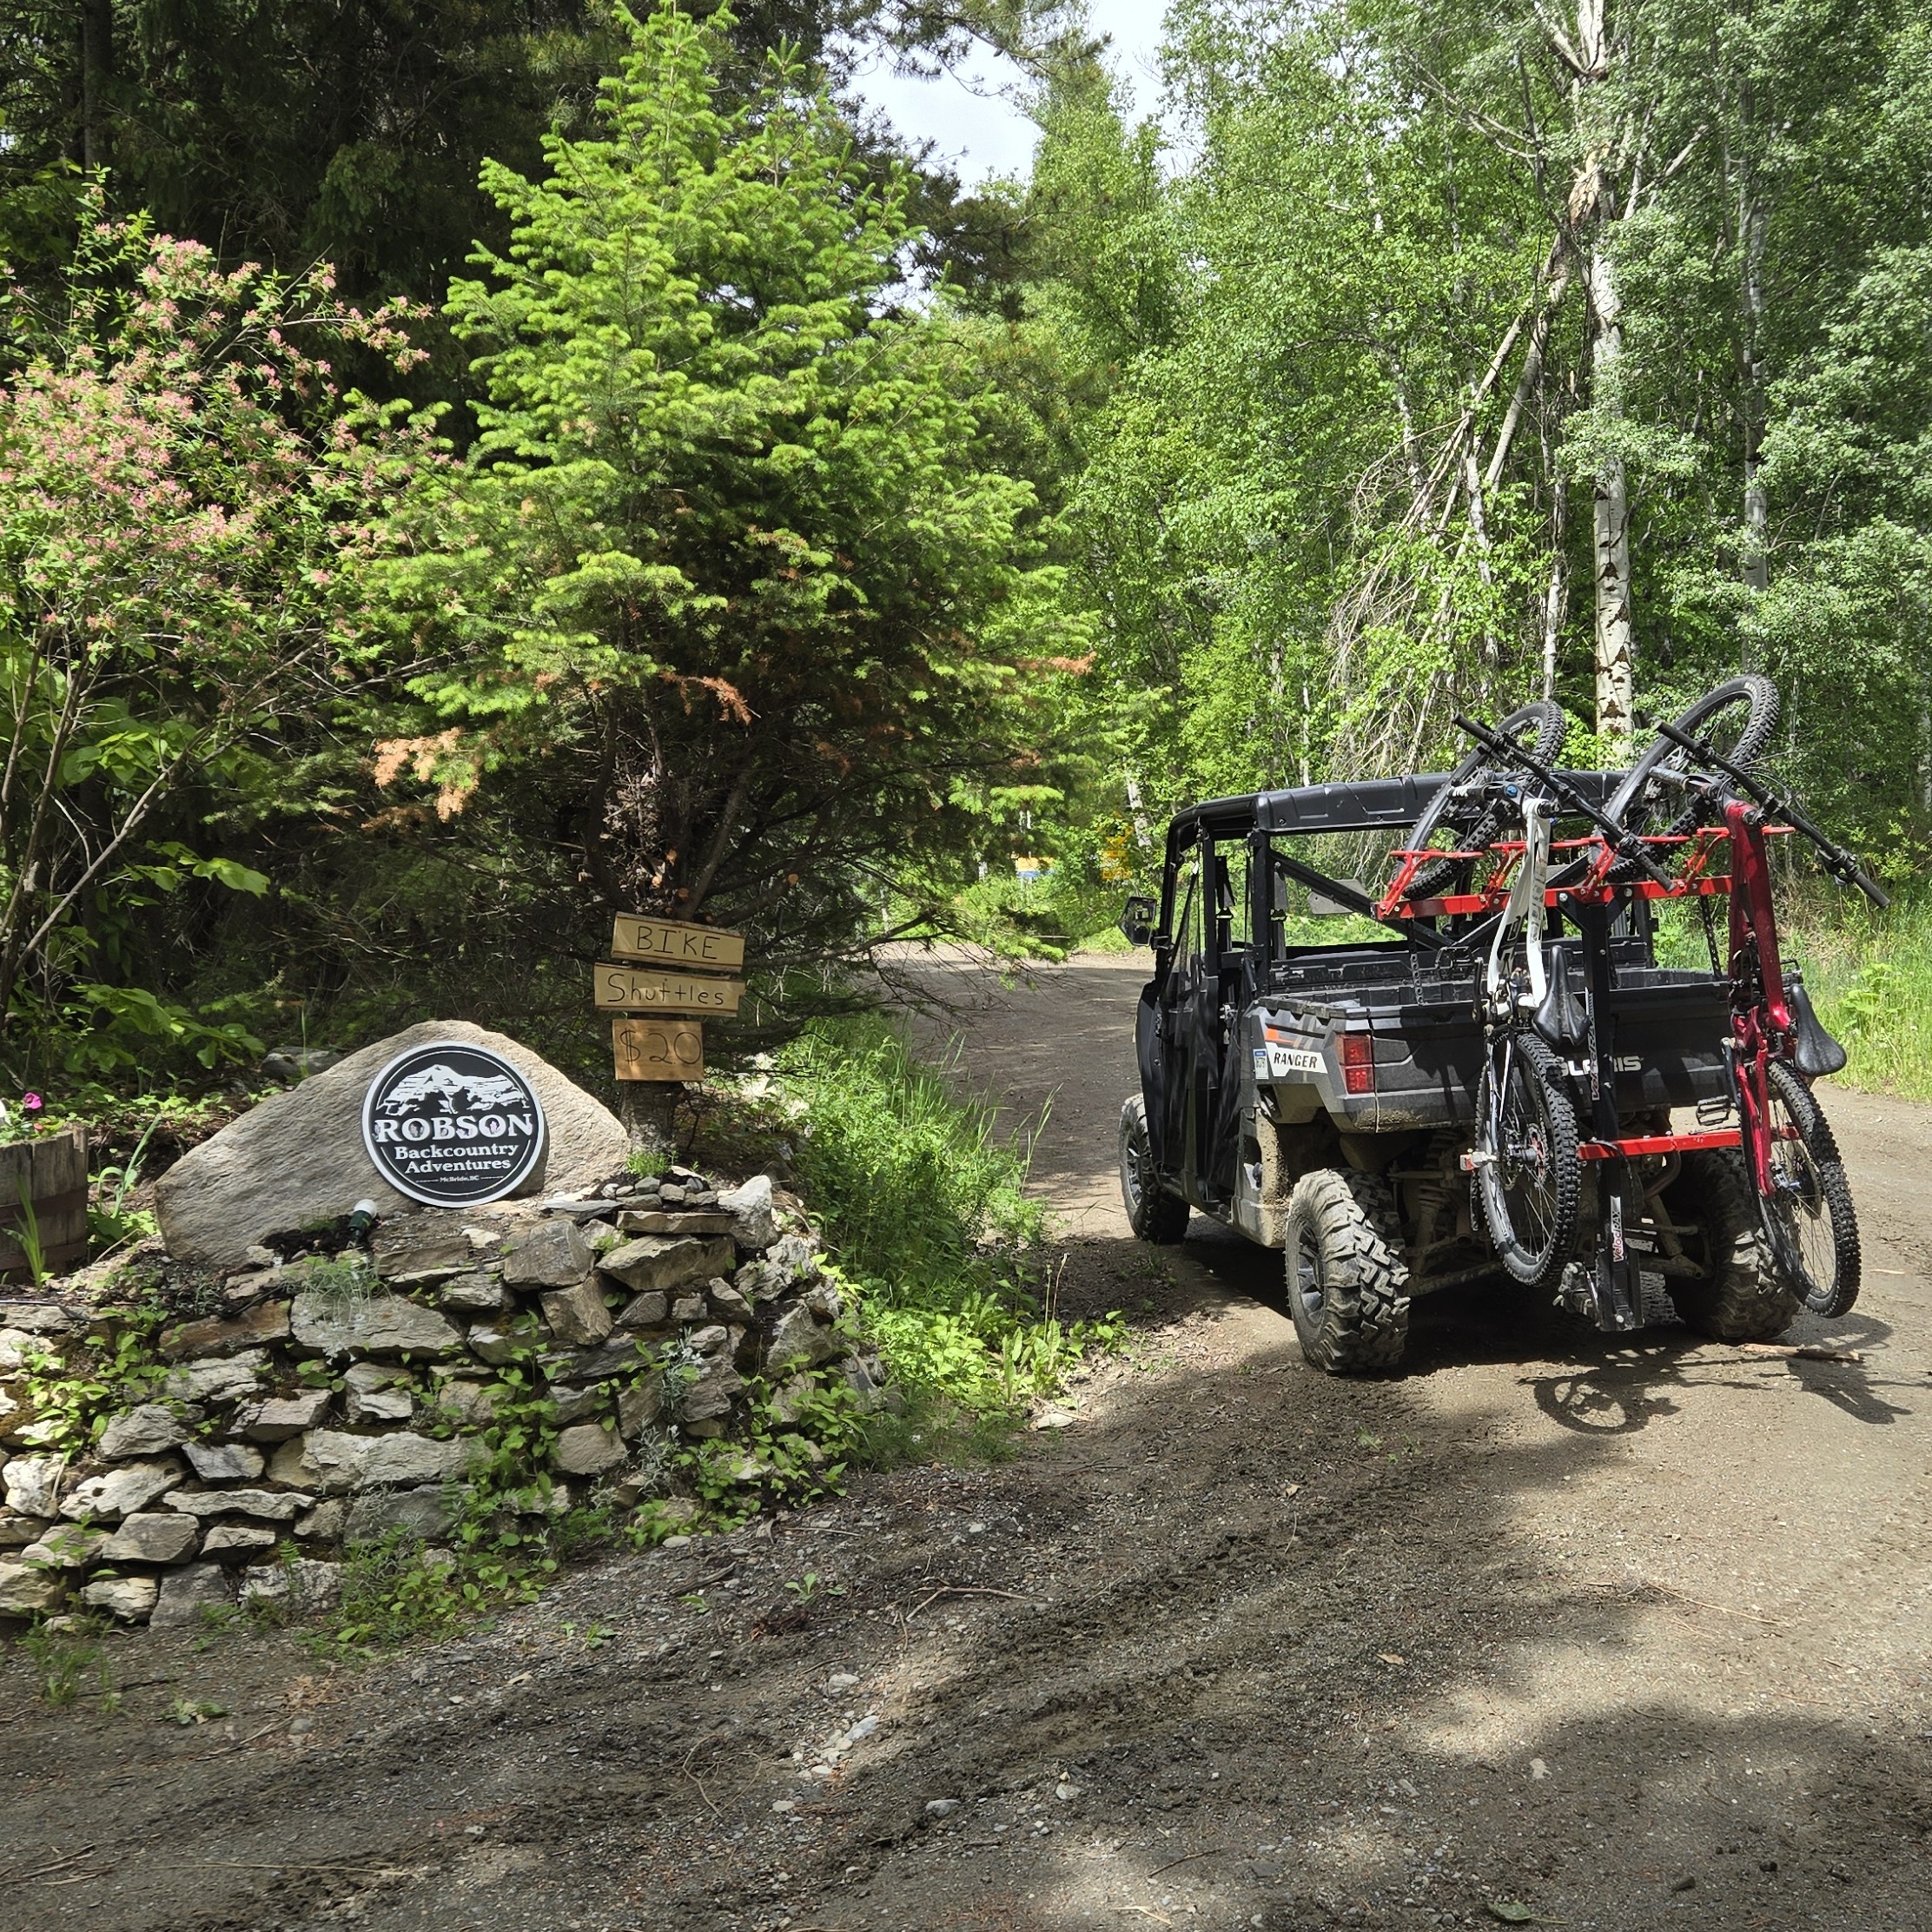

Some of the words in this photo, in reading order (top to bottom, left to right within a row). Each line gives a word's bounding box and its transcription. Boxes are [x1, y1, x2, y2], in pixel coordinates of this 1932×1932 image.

[637, 926, 720, 959] BIKE
[607, 973, 724, 1005] Shuttles
[619, 1028, 702, 1066] $20
[1274, 1052, 1318, 1069] RANGER
[374, 1113, 533, 1143] ROBSON
[394, 1143, 519, 1161] Backcountry
[404, 1159, 512, 1174] Adventures
